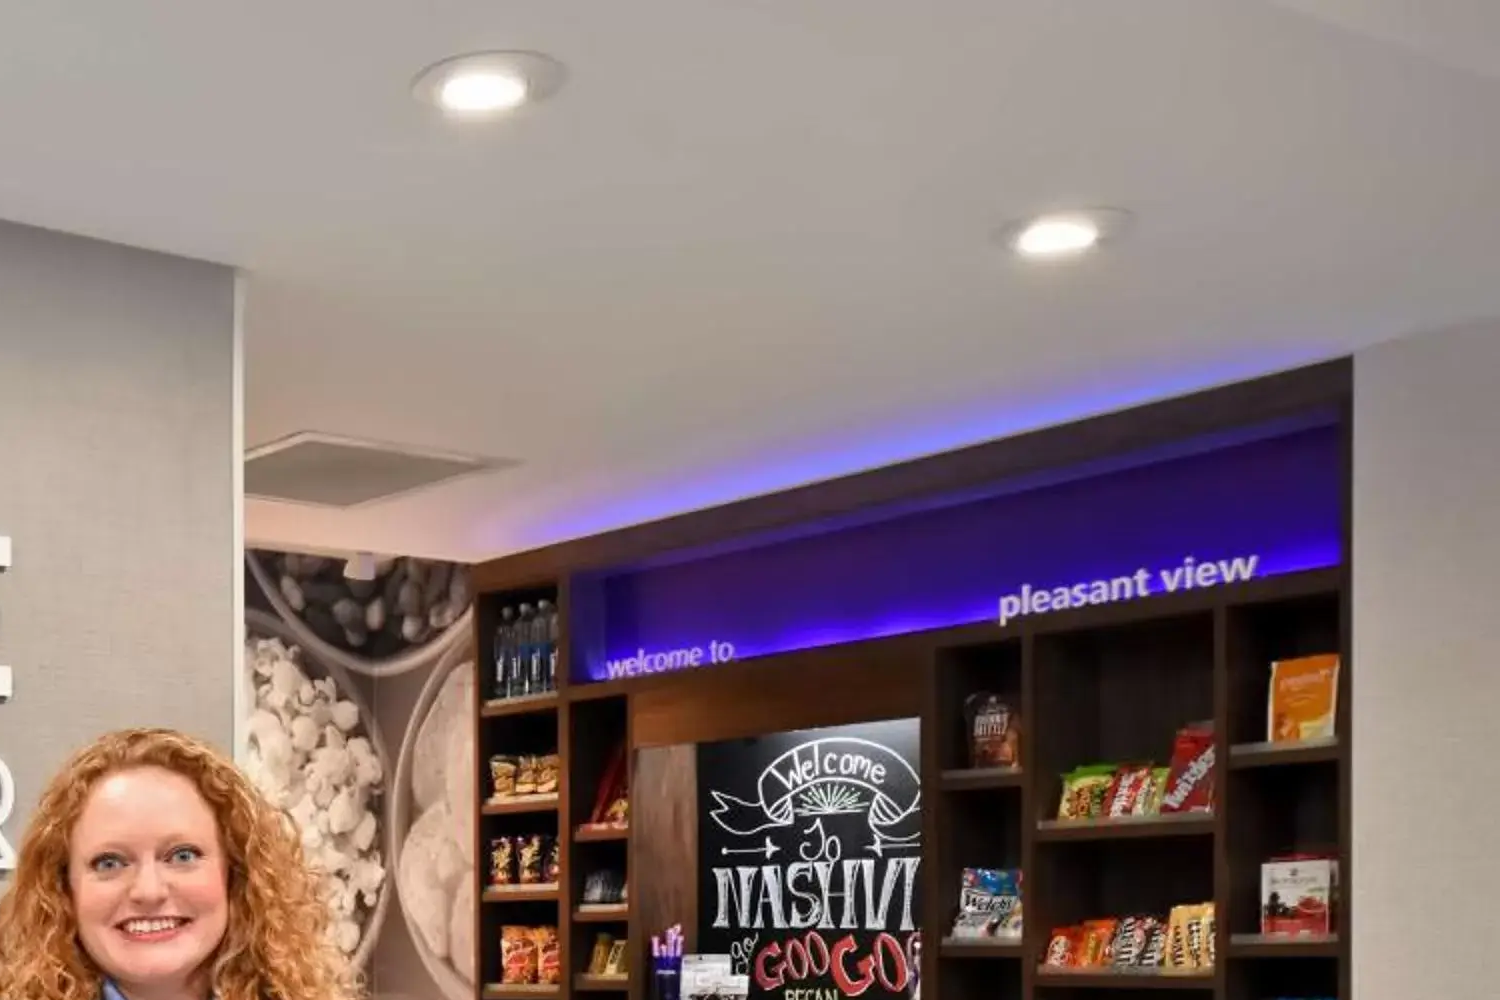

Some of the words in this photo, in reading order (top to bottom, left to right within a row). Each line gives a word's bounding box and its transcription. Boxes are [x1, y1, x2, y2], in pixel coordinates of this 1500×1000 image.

[606, 647, 703, 680] welcome
[708, 640, 735, 665] to
[999, 567, 1152, 627] pleasant
[1160, 555, 1258, 592] view
[770, 742, 887, 790] Welcome
[800, 818, 841, 862] To
[711, 857, 921, 931] NASHVI
